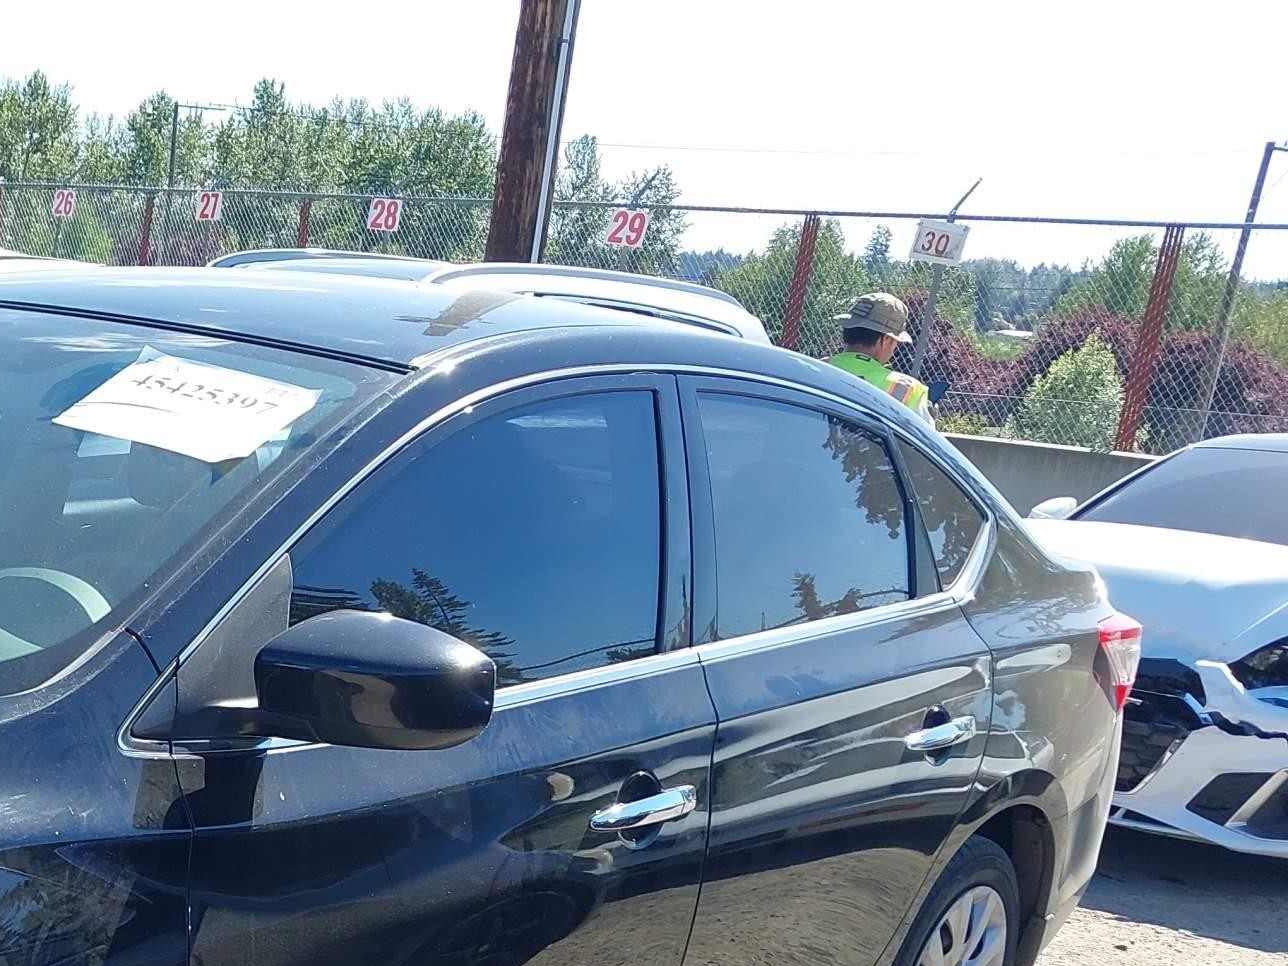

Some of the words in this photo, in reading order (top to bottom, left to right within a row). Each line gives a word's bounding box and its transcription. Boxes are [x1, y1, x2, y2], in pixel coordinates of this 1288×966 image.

[55, 191, 73, 216] 26
[199, 192, 221, 220] 27
[372, 201, 397, 231] 28
[607, 211, 647, 246] 29
[921, 230, 950, 256] 30
[132, 374, 281, 415] 45425397
